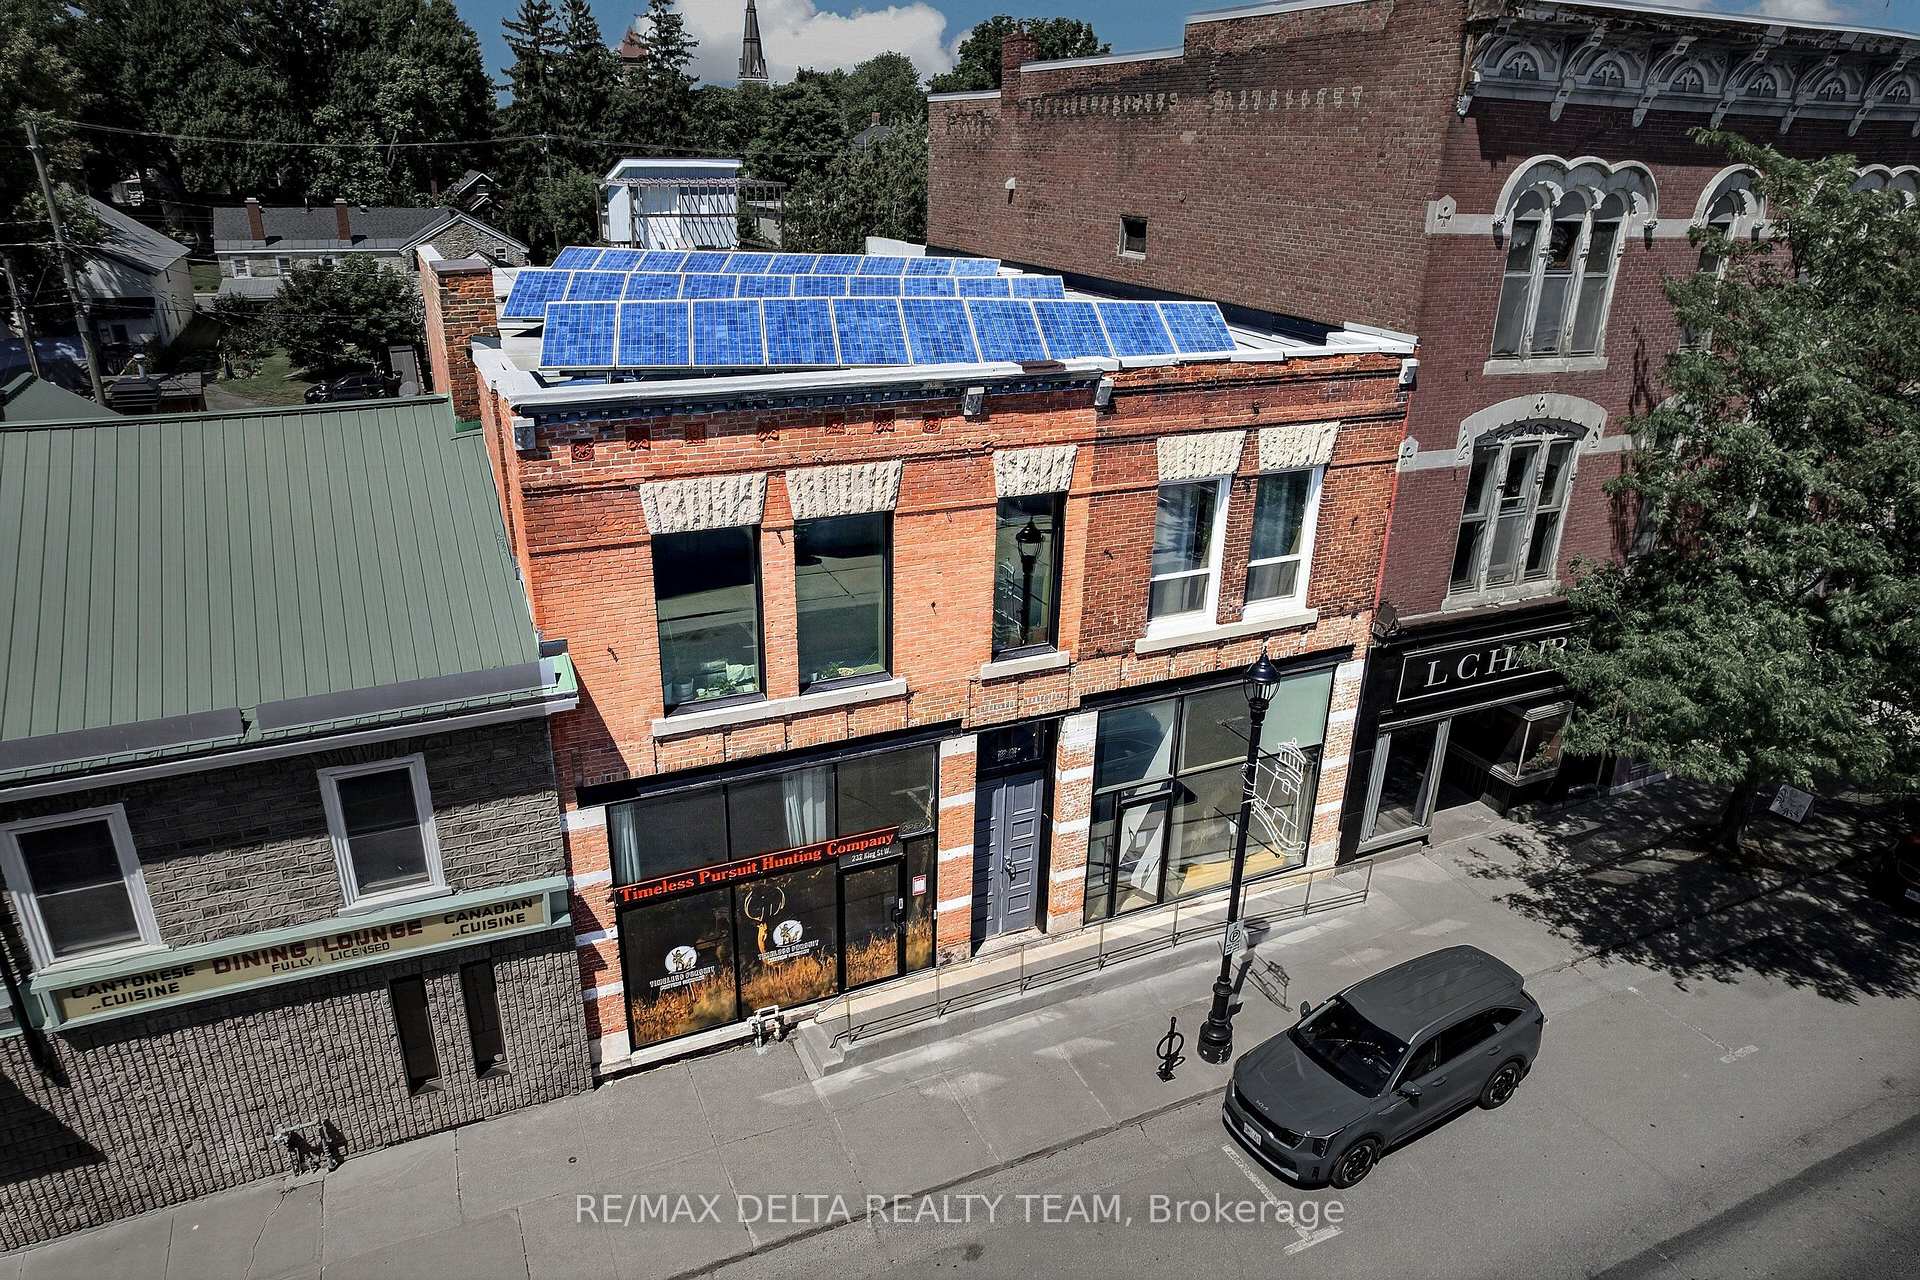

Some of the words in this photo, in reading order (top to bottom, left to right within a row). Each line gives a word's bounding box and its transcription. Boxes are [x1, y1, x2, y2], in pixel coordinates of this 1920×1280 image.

[620, 878, 696, 902] Timeless
[699, 862, 758, 885] Pursuit
[761, 849, 823, 870] Hunting
[826, 833, 895, 856] Company
[443, 898, 533, 924] CANADIAN
[213, 942, 308, 975] DINING
[322, 919, 424, 953] LOUNGE
[271, 956, 316, 973] FULLY
[330, 941, 391, 961] LICENSED
[71, 965, 196, 999] CANTONESE
